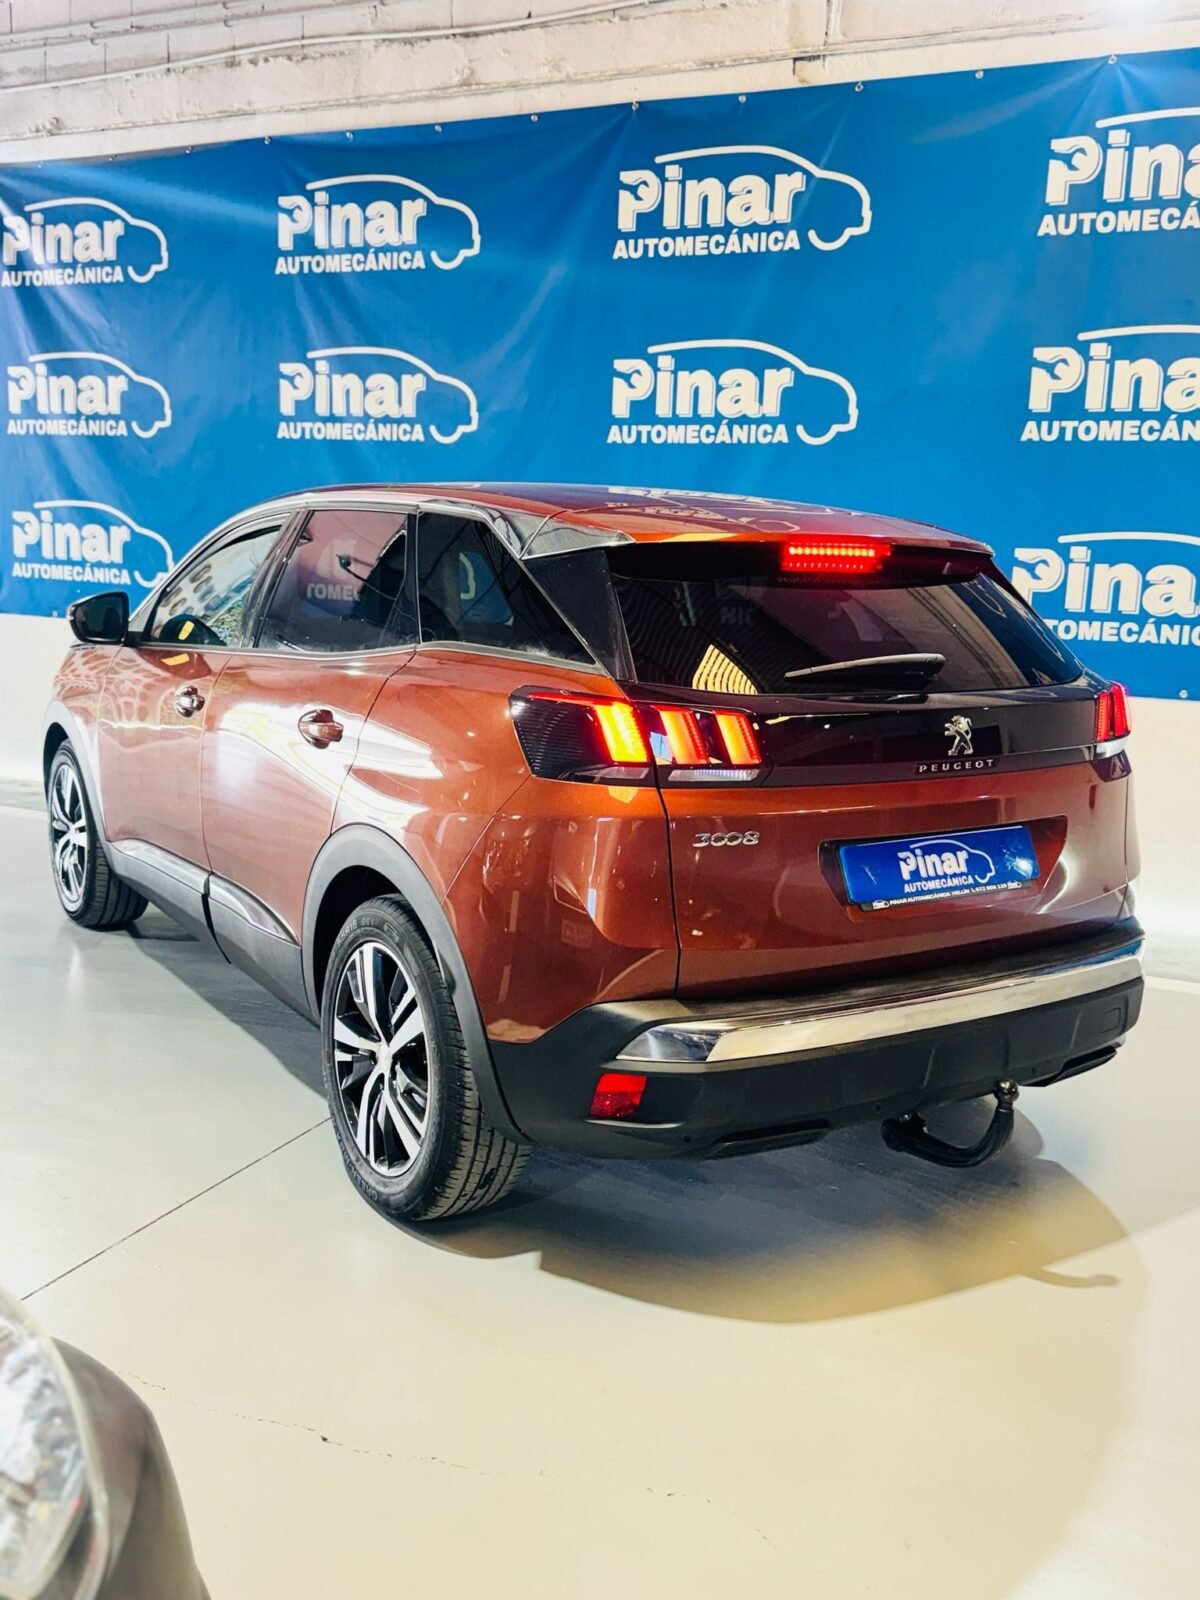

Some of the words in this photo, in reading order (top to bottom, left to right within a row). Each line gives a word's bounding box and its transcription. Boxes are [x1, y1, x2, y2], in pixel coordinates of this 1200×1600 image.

[616, 164, 806, 232] Pinar
[277, 191, 427, 251] Pinar
[3, 212, 125, 266] Pinar
[612, 229, 800, 260] AUTOMECÁNICA
[1, 267, 124, 287] AUTOMECÁNICA
[275, 249, 425, 275] AUTOMECÁNICA
[7, 363, 128, 415] Pinar
[278, 361, 426, 418] Pinar
[611, 355, 794, 419] Pinar
[7, 417, 128, 437] AUTOMECÁNICA
[276, 419, 425, 442] AUTOMECÁNICA
[607, 418, 789, 445] AUTOMECÁNICA
[11, 511, 131, 564] Pinar
[11, 562, 131, 585] AUTOMECÁNICA
[1011, 546, 1200, 618] Pina
[917, 758, 995, 773] PEUGEOT
[691, 831, 760, 848] 3008
[897, 848, 969, 881] Pinar
[904, 873, 974, 893] AUTOMECÁNICA
